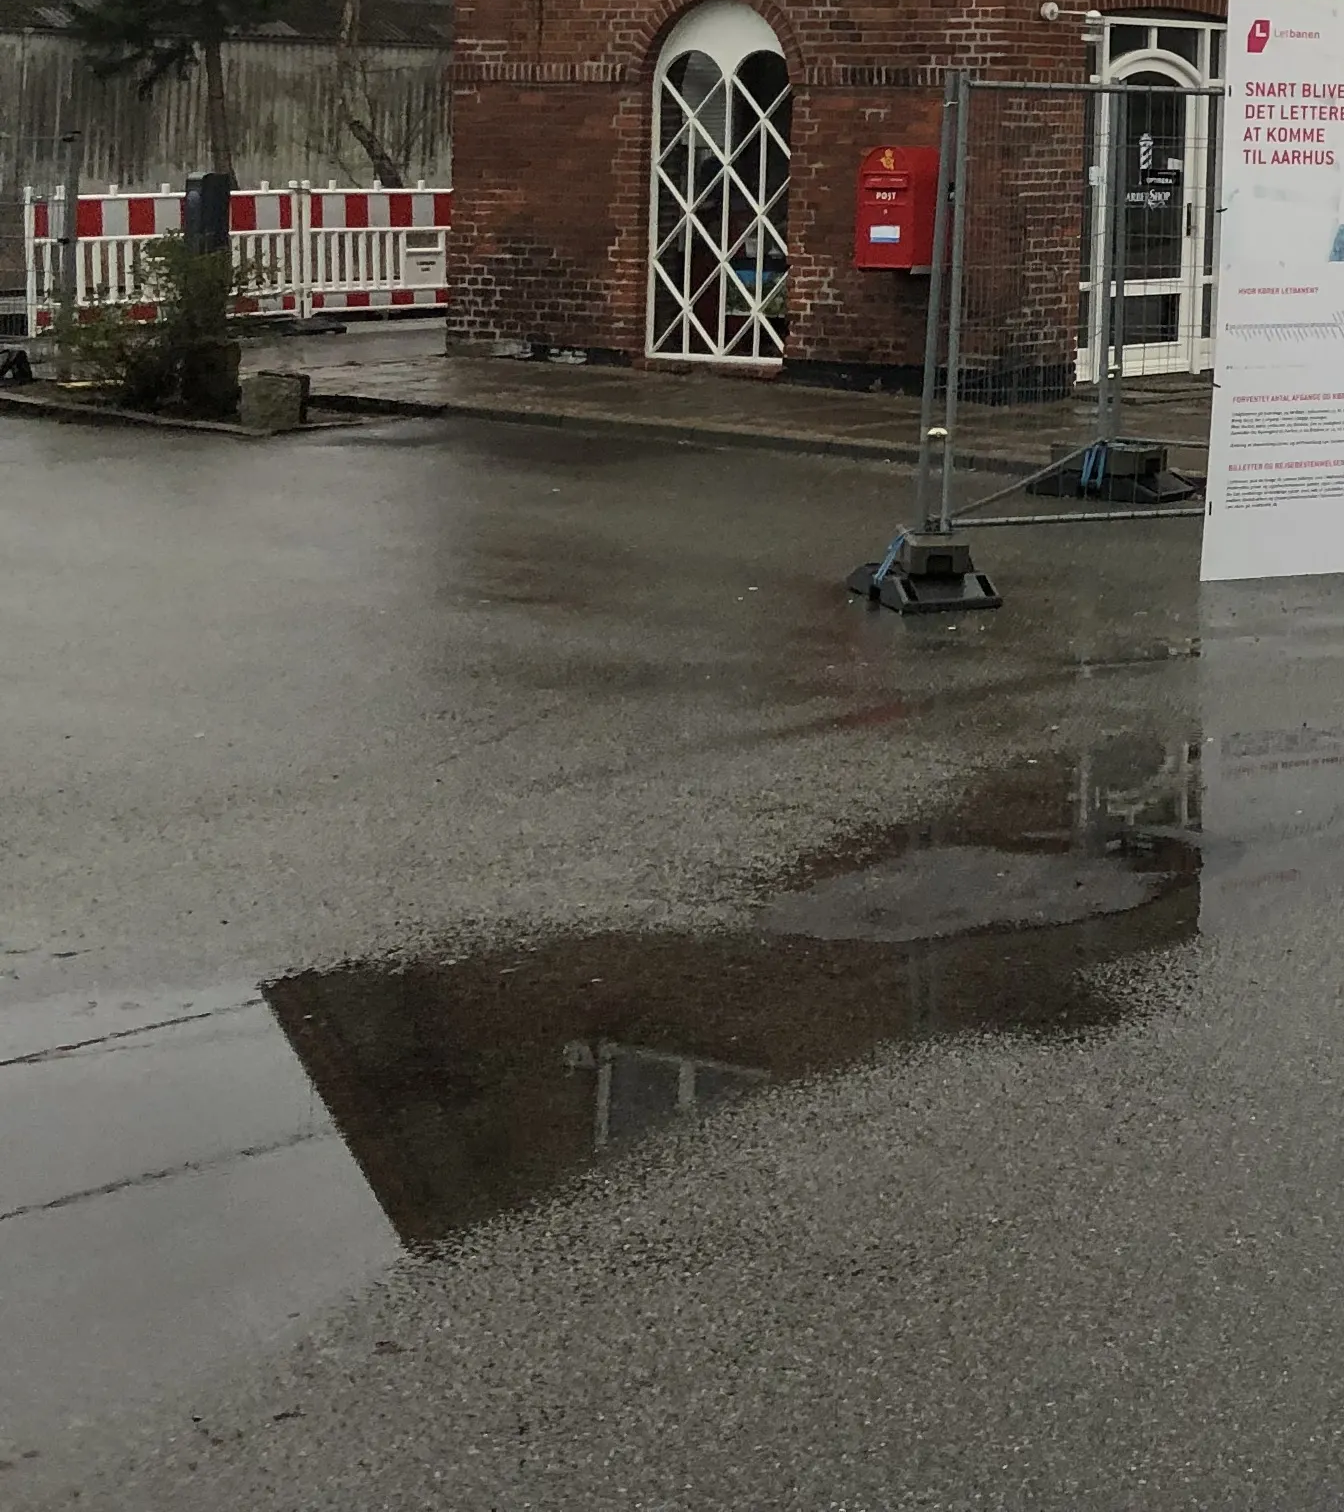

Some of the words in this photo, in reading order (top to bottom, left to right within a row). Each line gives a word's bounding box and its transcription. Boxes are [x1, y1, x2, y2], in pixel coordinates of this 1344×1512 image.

[1274, 28, 1321, 39] Letbanen
[1245, 82, 1297, 97] SNART
[1245, 104, 1275, 120] DET
[1243, 127, 1262, 142] AT
[1267, 127, 1326, 143] KOMME
[1243, 149, 1267, 165] TIL
[1271, 150, 1335, 165] AARHUS
[876, 192, 897, 201] POST
[1228, 463, 1263, 472] BILLETTER
[1264, 462, 1274, 470] OG
